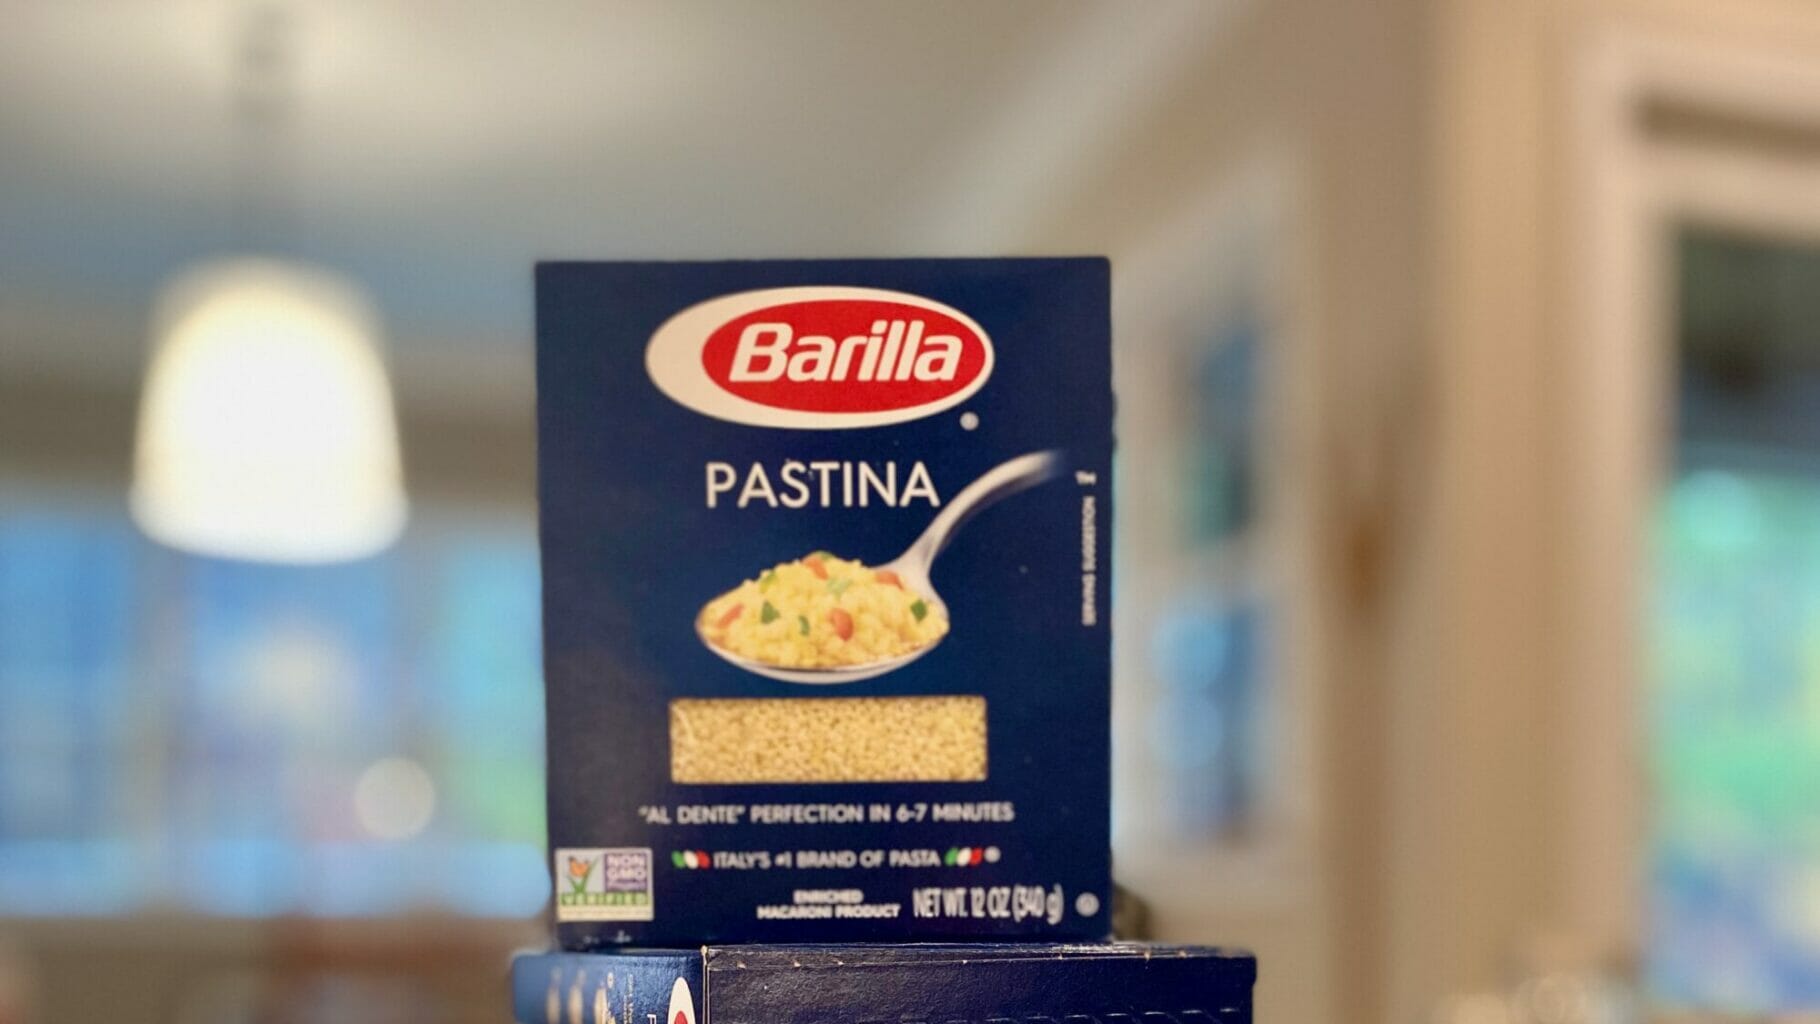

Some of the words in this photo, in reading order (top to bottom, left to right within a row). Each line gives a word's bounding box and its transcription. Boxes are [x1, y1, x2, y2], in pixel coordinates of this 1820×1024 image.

[728, 320, 964, 383] Barilla
[705, 460, 941, 509] PASTINA
[751, 803, 864, 824] PERFECTION
[869, 803, 891, 822] IN
[896, 803, 928, 822] 6-7
[933, 802, 1015, 823] MINUTES
[713, 851, 771, 869] ITALY'S
[796, 850, 857, 868] BRAND
[860, 850, 885, 867] OF
[889, 850, 941, 867] PASTA
[757, 904, 832, 919] MACARONI
[835, 903, 901, 918] PRODUCT
[913, 887, 941, 918] NET
[943, 887, 968, 918] WT.
[970, 887, 985, 917] 12
[987, 887, 1010, 918] OZ
